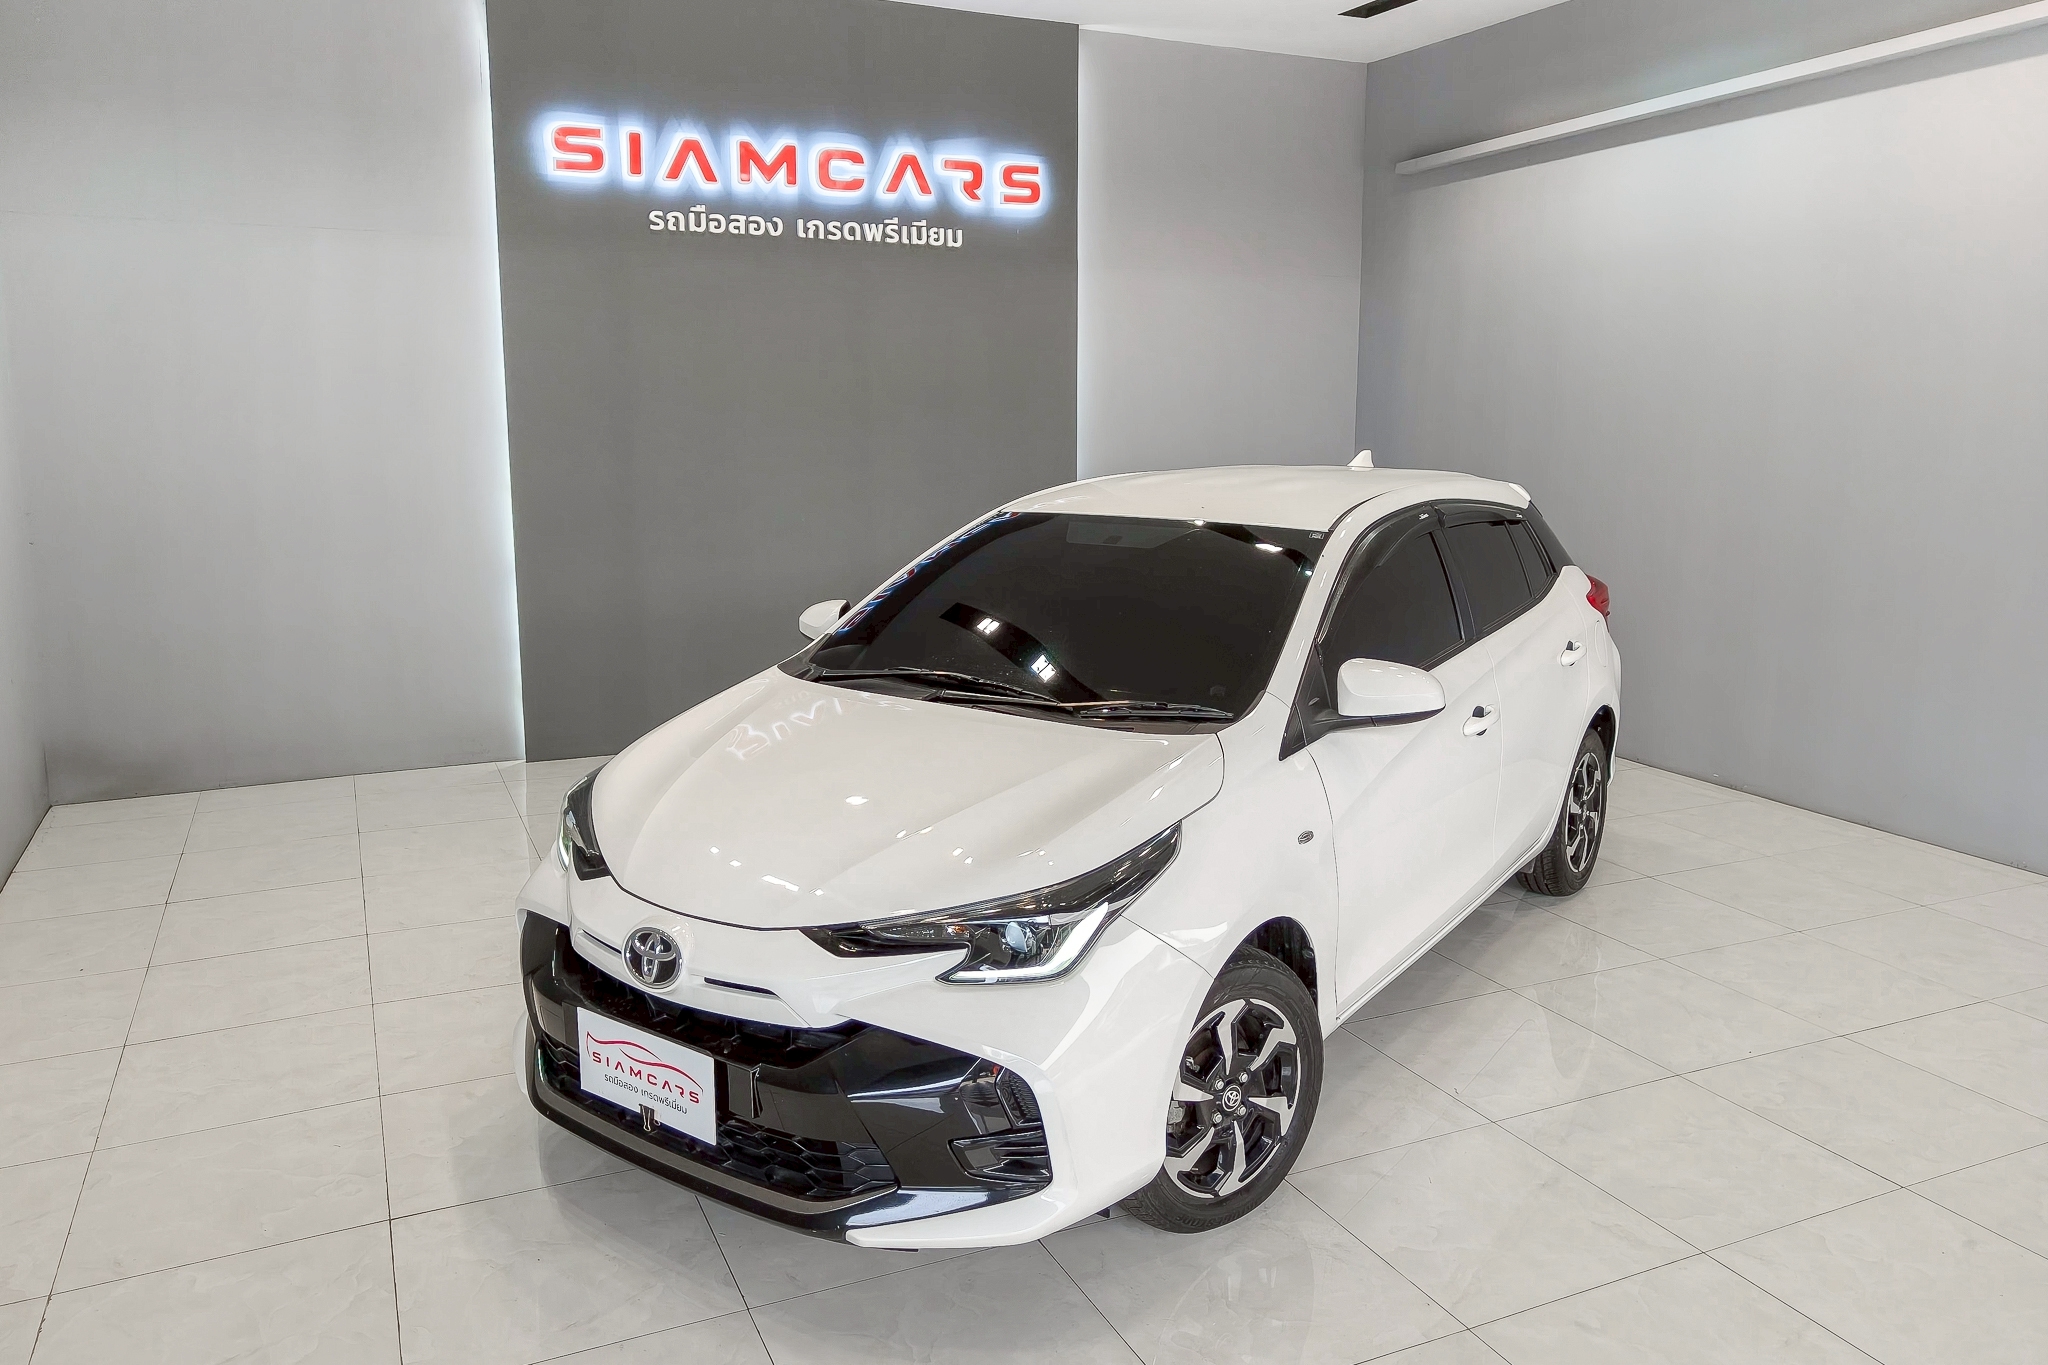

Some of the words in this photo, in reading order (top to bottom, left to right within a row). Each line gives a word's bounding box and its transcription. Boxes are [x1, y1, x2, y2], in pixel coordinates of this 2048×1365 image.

[552, 124, 1041, 205] SIAMCARS
[648, 204, 784, 237] รถมือสอง
[796, 217, 964, 248] เกรดพรีเมียม
[592, 1051, 700, 1104] SIAMCARS
[604, 1073, 639, 1094] รถมือสอง
[641, 1088, 688, 1115] เกรดพรีเมียม
